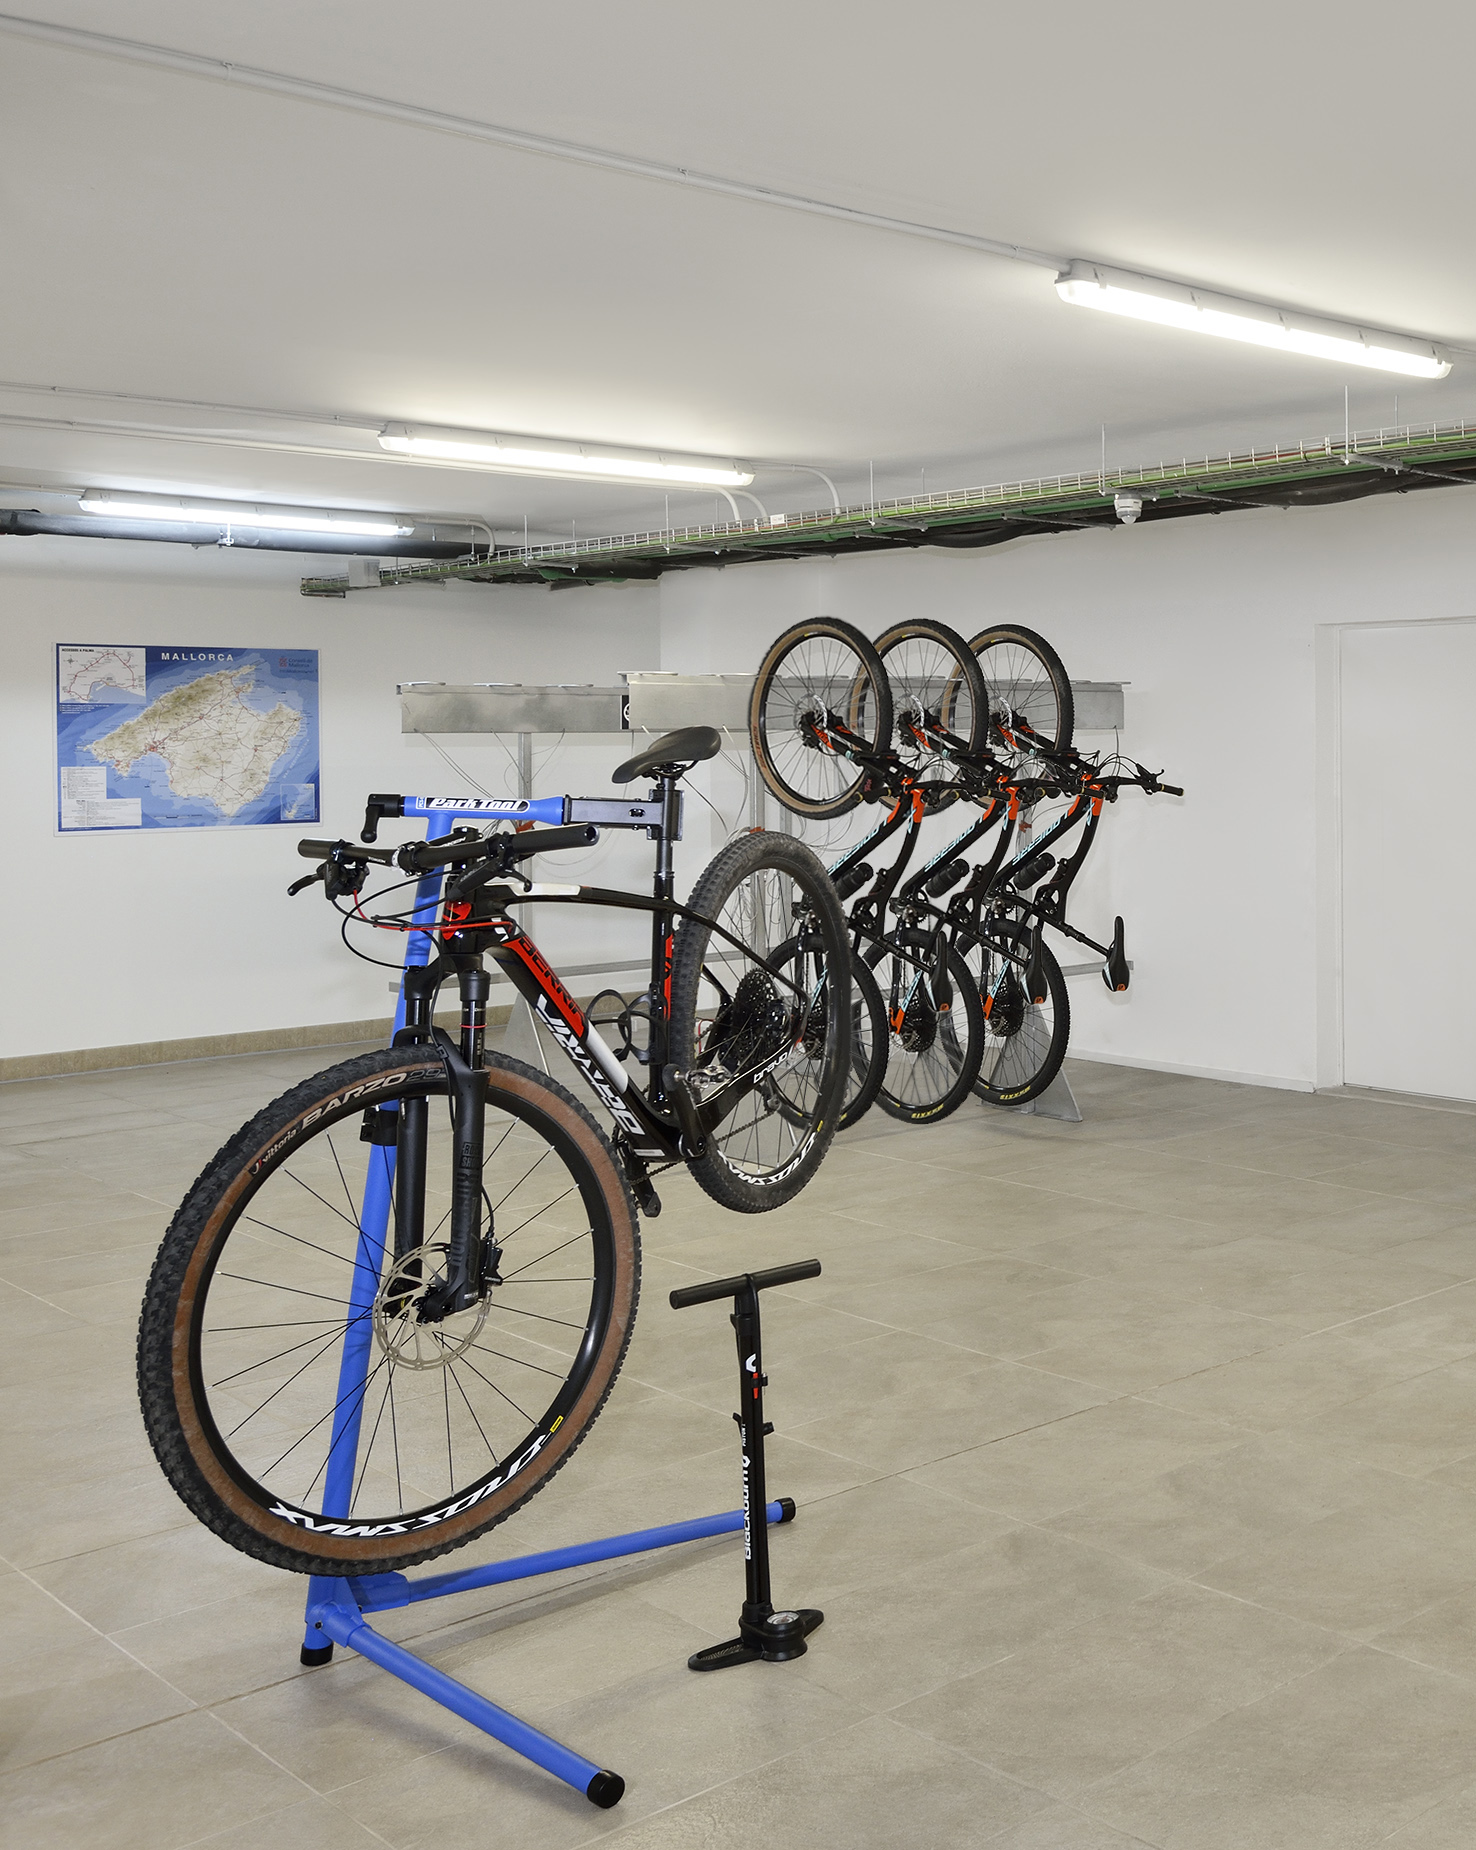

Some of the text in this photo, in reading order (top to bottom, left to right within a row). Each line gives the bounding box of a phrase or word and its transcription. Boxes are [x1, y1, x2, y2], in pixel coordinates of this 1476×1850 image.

[161, 652, 234, 662] MALLORCA
[261, 1068, 441, 1163] vittoria BARZO 29
[269, 1435, 546, 1537] CROSSMAX
